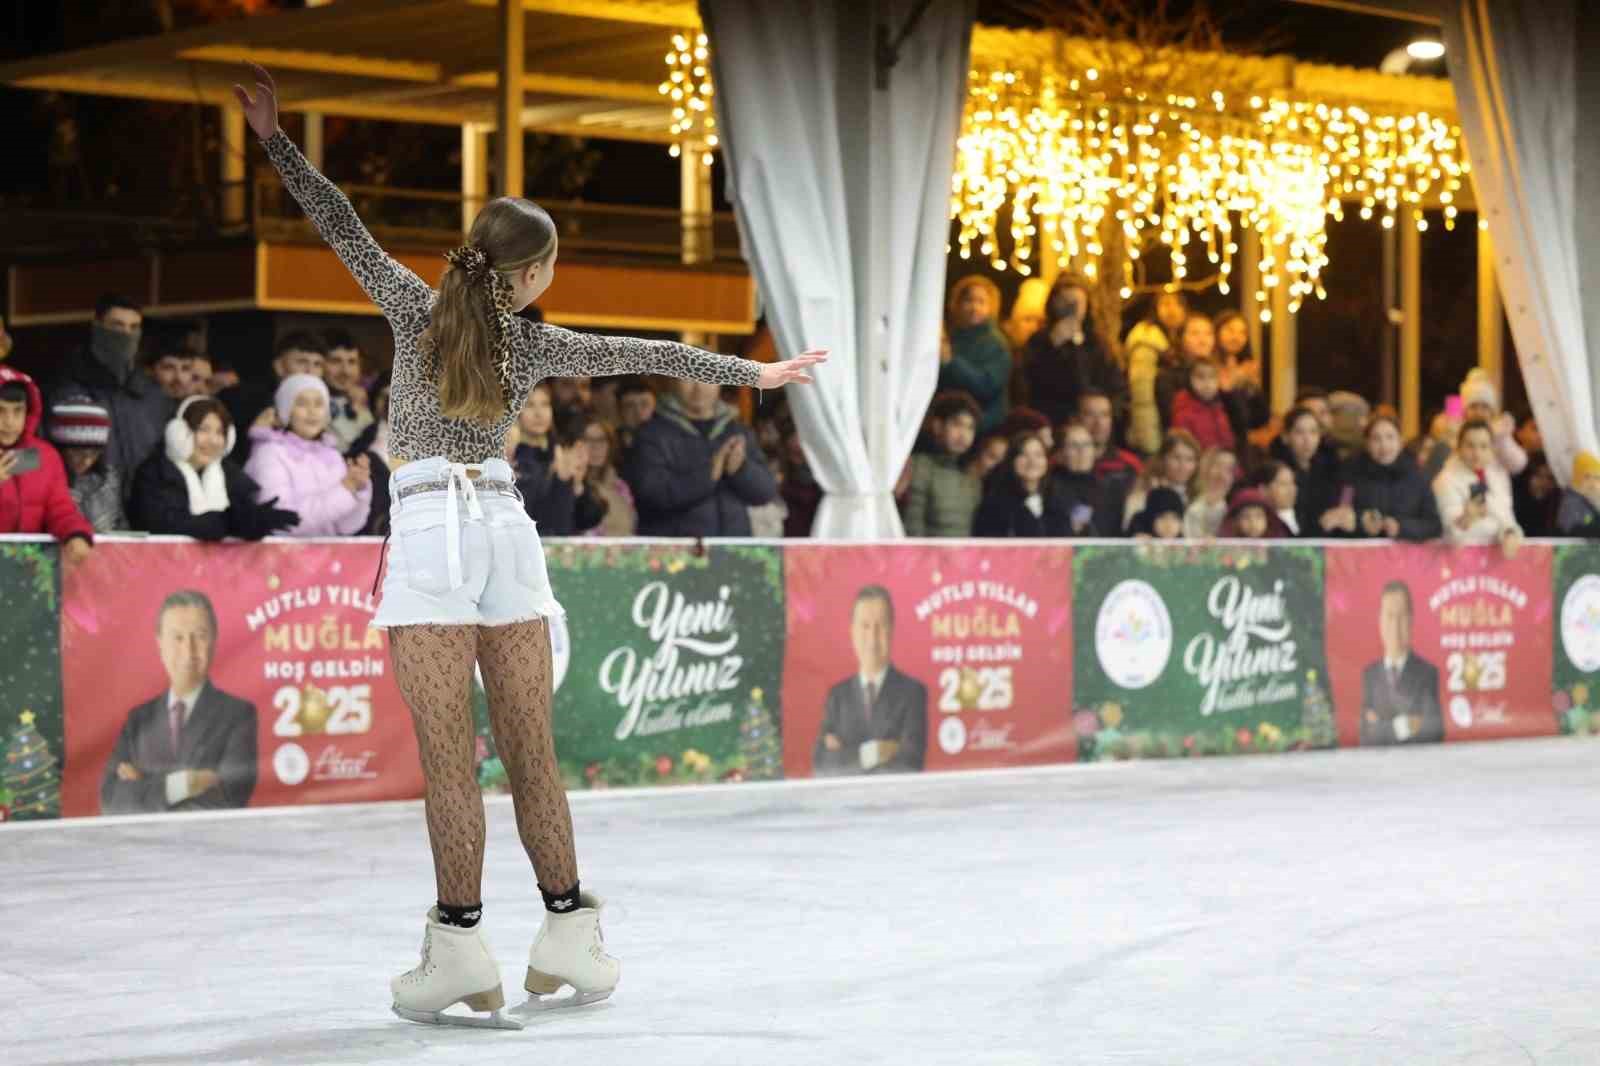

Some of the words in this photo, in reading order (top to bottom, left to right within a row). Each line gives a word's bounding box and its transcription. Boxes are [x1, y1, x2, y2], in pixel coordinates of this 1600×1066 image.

[246, 586, 322, 631] MUTLU
[632, 581, 738, 657] Yeni
[264, 613, 384, 651] MUĞLA
[264, 660, 305, 683] HOŞ
[310, 655, 385, 679] GELDİN
